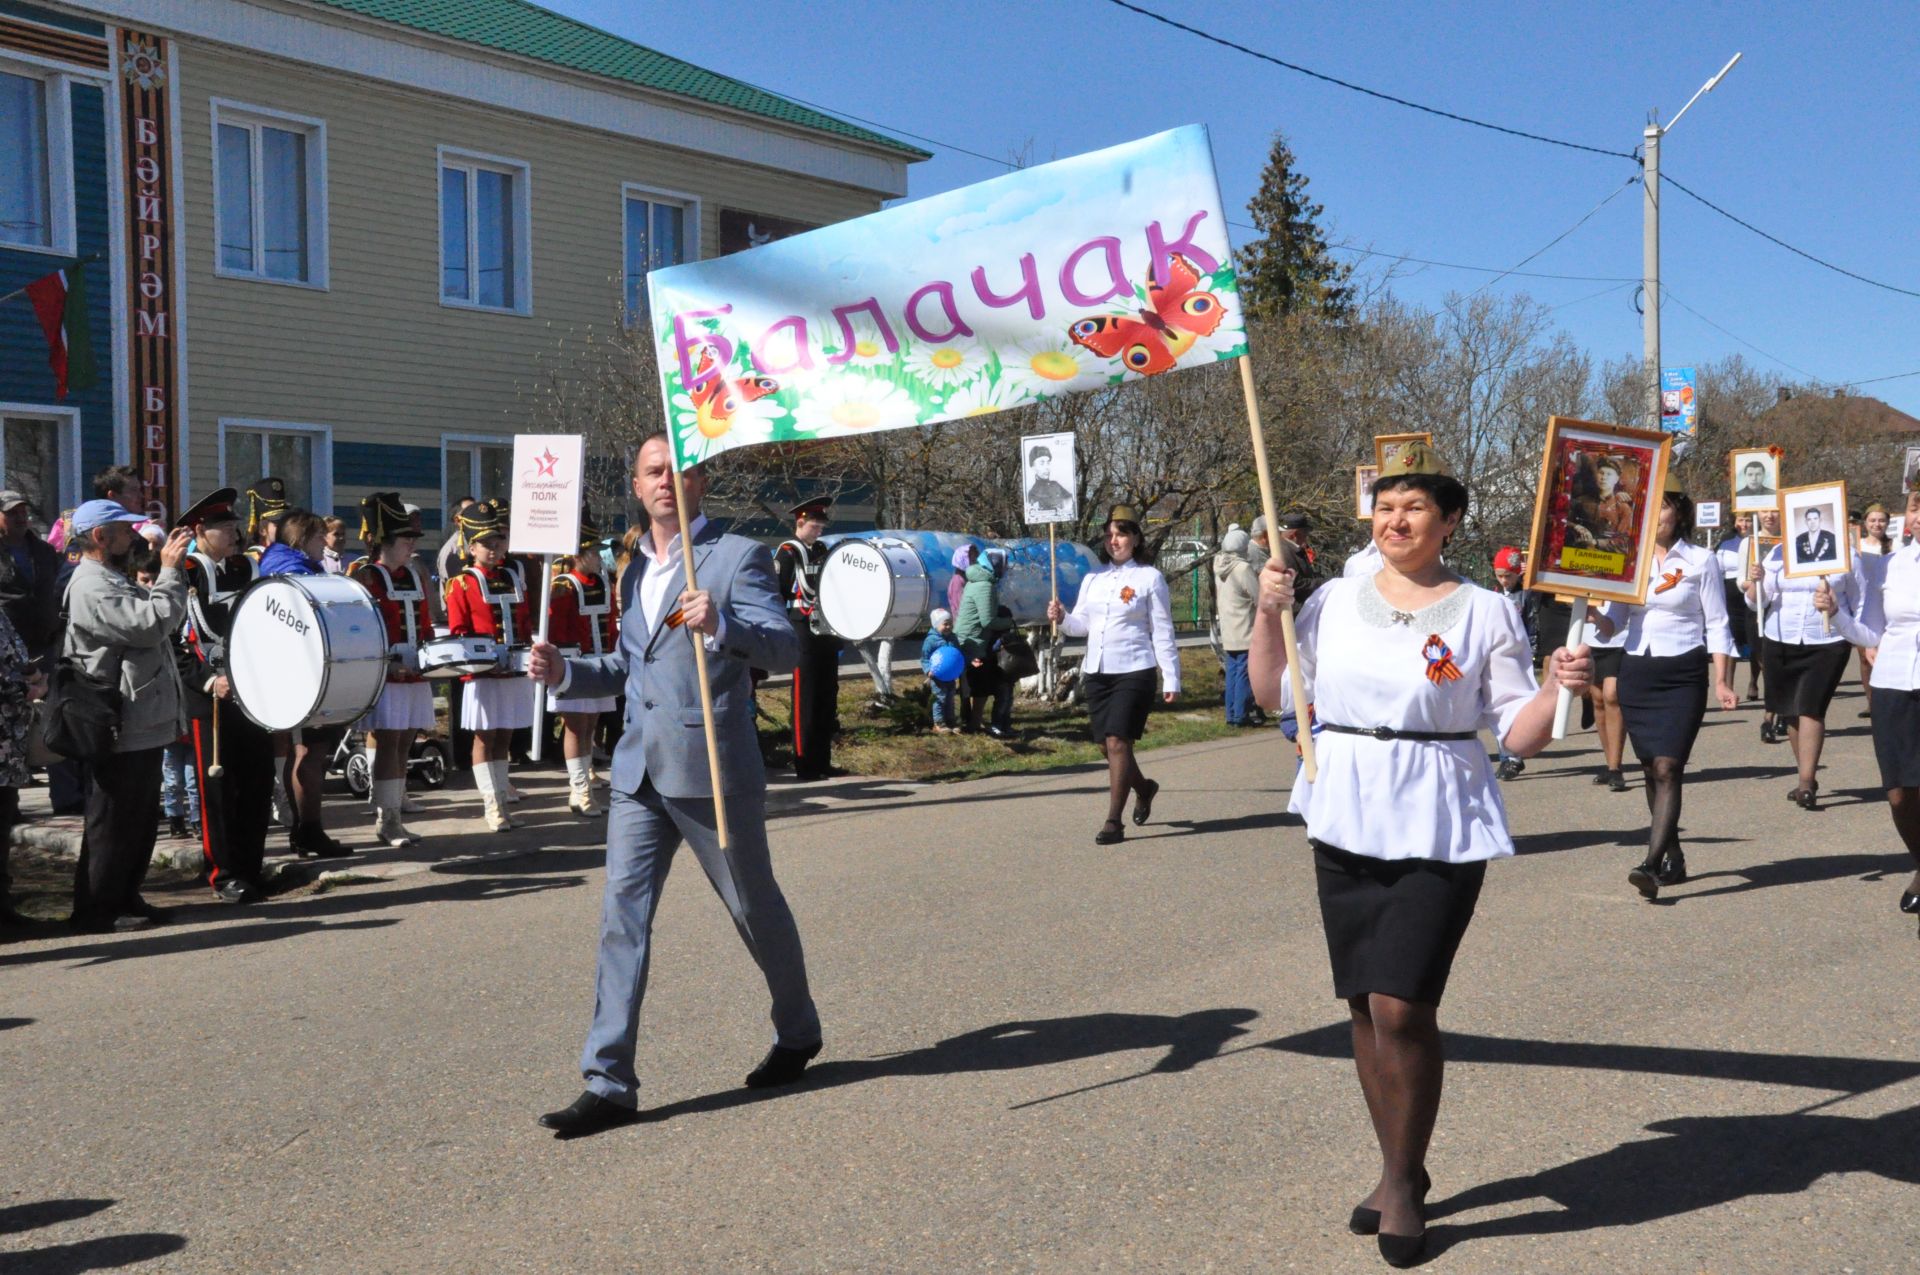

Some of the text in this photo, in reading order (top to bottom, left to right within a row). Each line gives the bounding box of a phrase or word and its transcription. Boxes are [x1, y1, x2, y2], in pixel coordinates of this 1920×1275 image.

[135, 117, 168, 338] БӘЙРӘМ
[673, 209, 1220, 390] Балачак
[531, 491, 557, 501] ПОЛК
[842, 551, 880, 573] Weber
[265, 595, 311, 637] Weber
